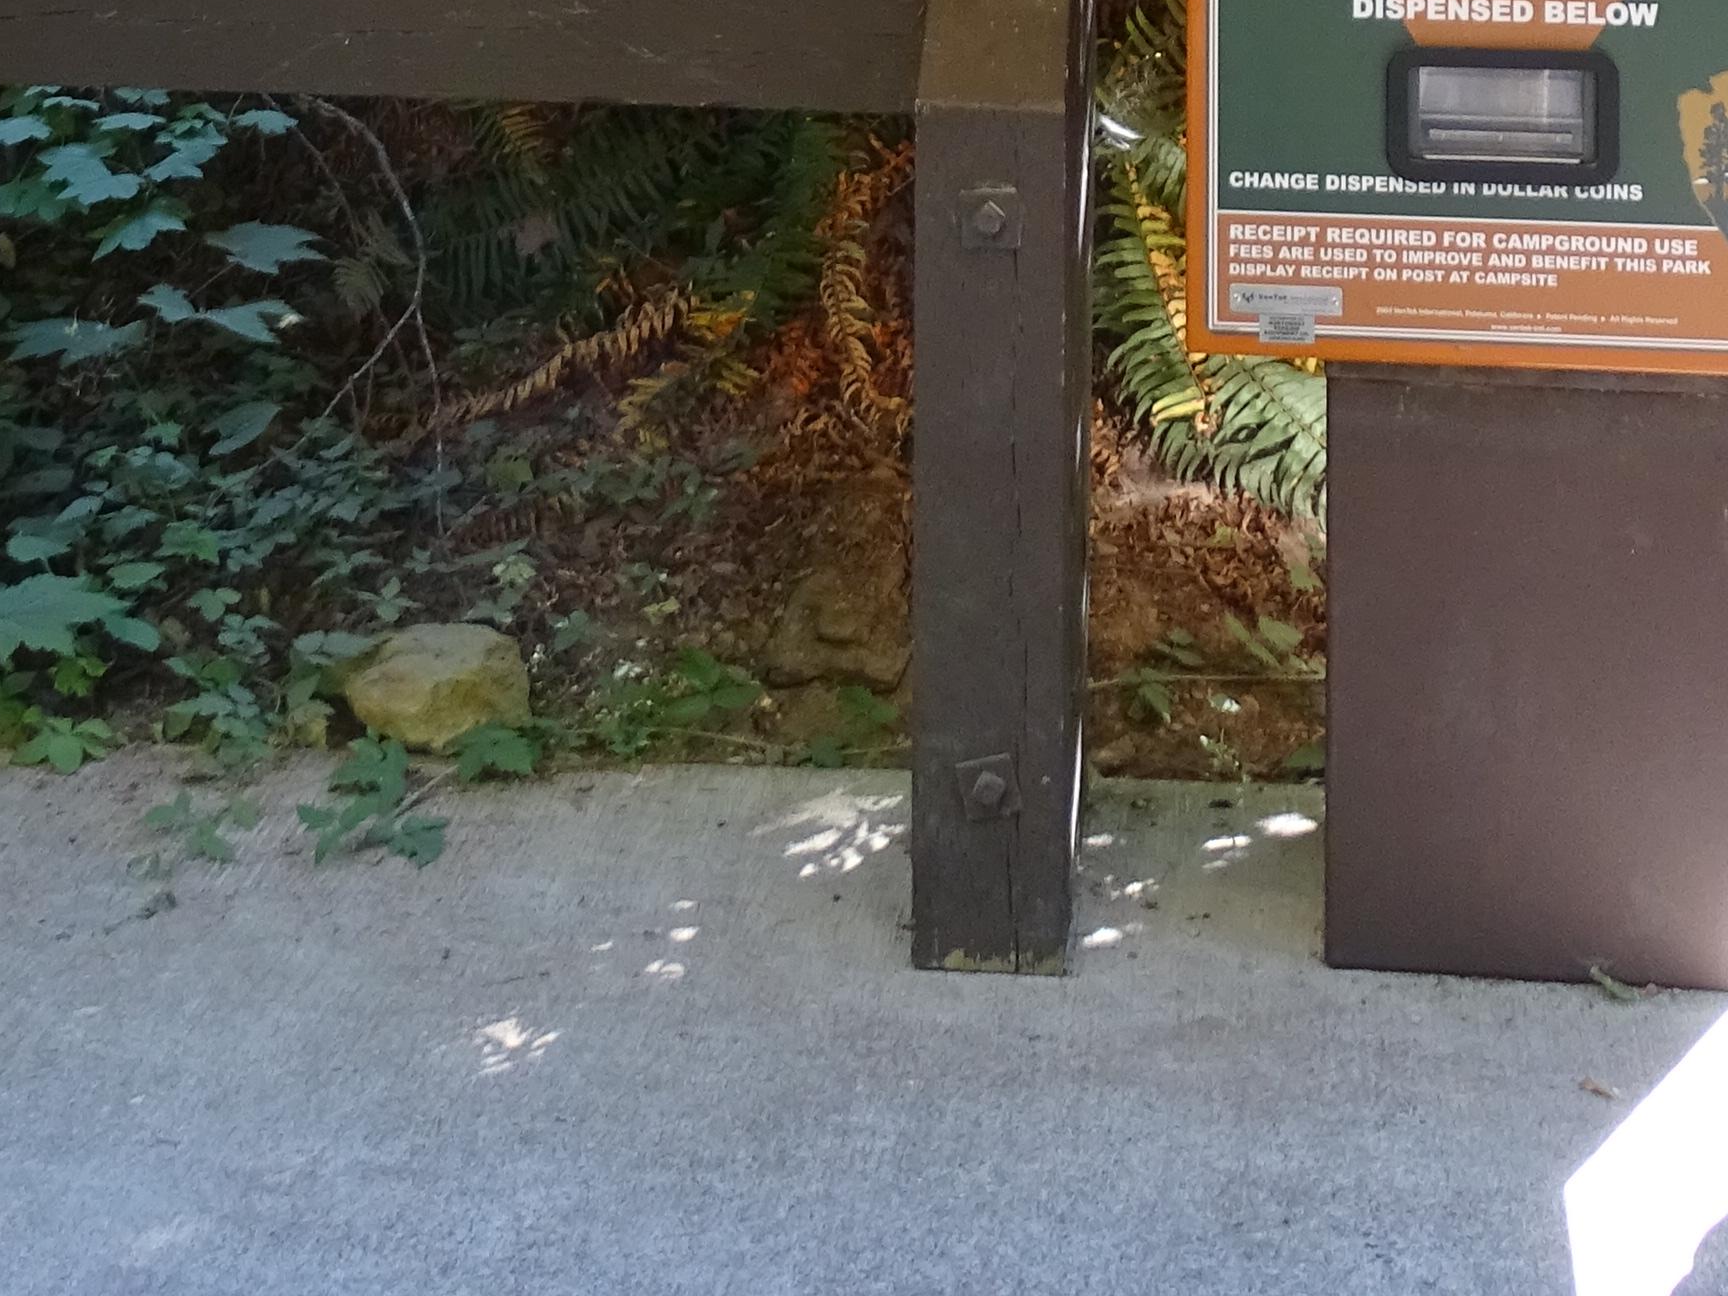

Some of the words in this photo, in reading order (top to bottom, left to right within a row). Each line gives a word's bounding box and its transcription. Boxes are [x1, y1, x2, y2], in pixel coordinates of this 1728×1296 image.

[1545, 1, 1658, 27] BELOW
[1230, 171, 1319, 190] CHANGE
[1230, 224, 1320, 242] RECEIPT
[1327, 227, 1436, 246] REQUIRED
[1444, 231, 1486, 249] FOR
[1493, 233, 1648, 254] CAMPGROUND
[1655, 239, 1697, 256] USE
[1230, 244, 1273, 259] FEES
[1279, 246, 1314, 260] ARE
[1320, 248, 1367, 262] USED
[1373, 249, 1397, 263] TO
[1403, 251, 1483, 267] IMPROVE
[1488, 254, 1526, 268] AND
[1532, 255, 1609, 271] BENEFIT
[1614, 258, 1657, 273] THIS
[1663, 259, 1711, 274] PARK
[1229, 263, 1296, 277] DISPLAY
[1301, 266, 1369, 280] RECEIPT
[1374, 268, 1397, 281] ON
[1402, 269, 1445, 282] POST
[1450, 271, 1470, 284] AT
[1475, 272, 1557, 287] CAMPSITE
